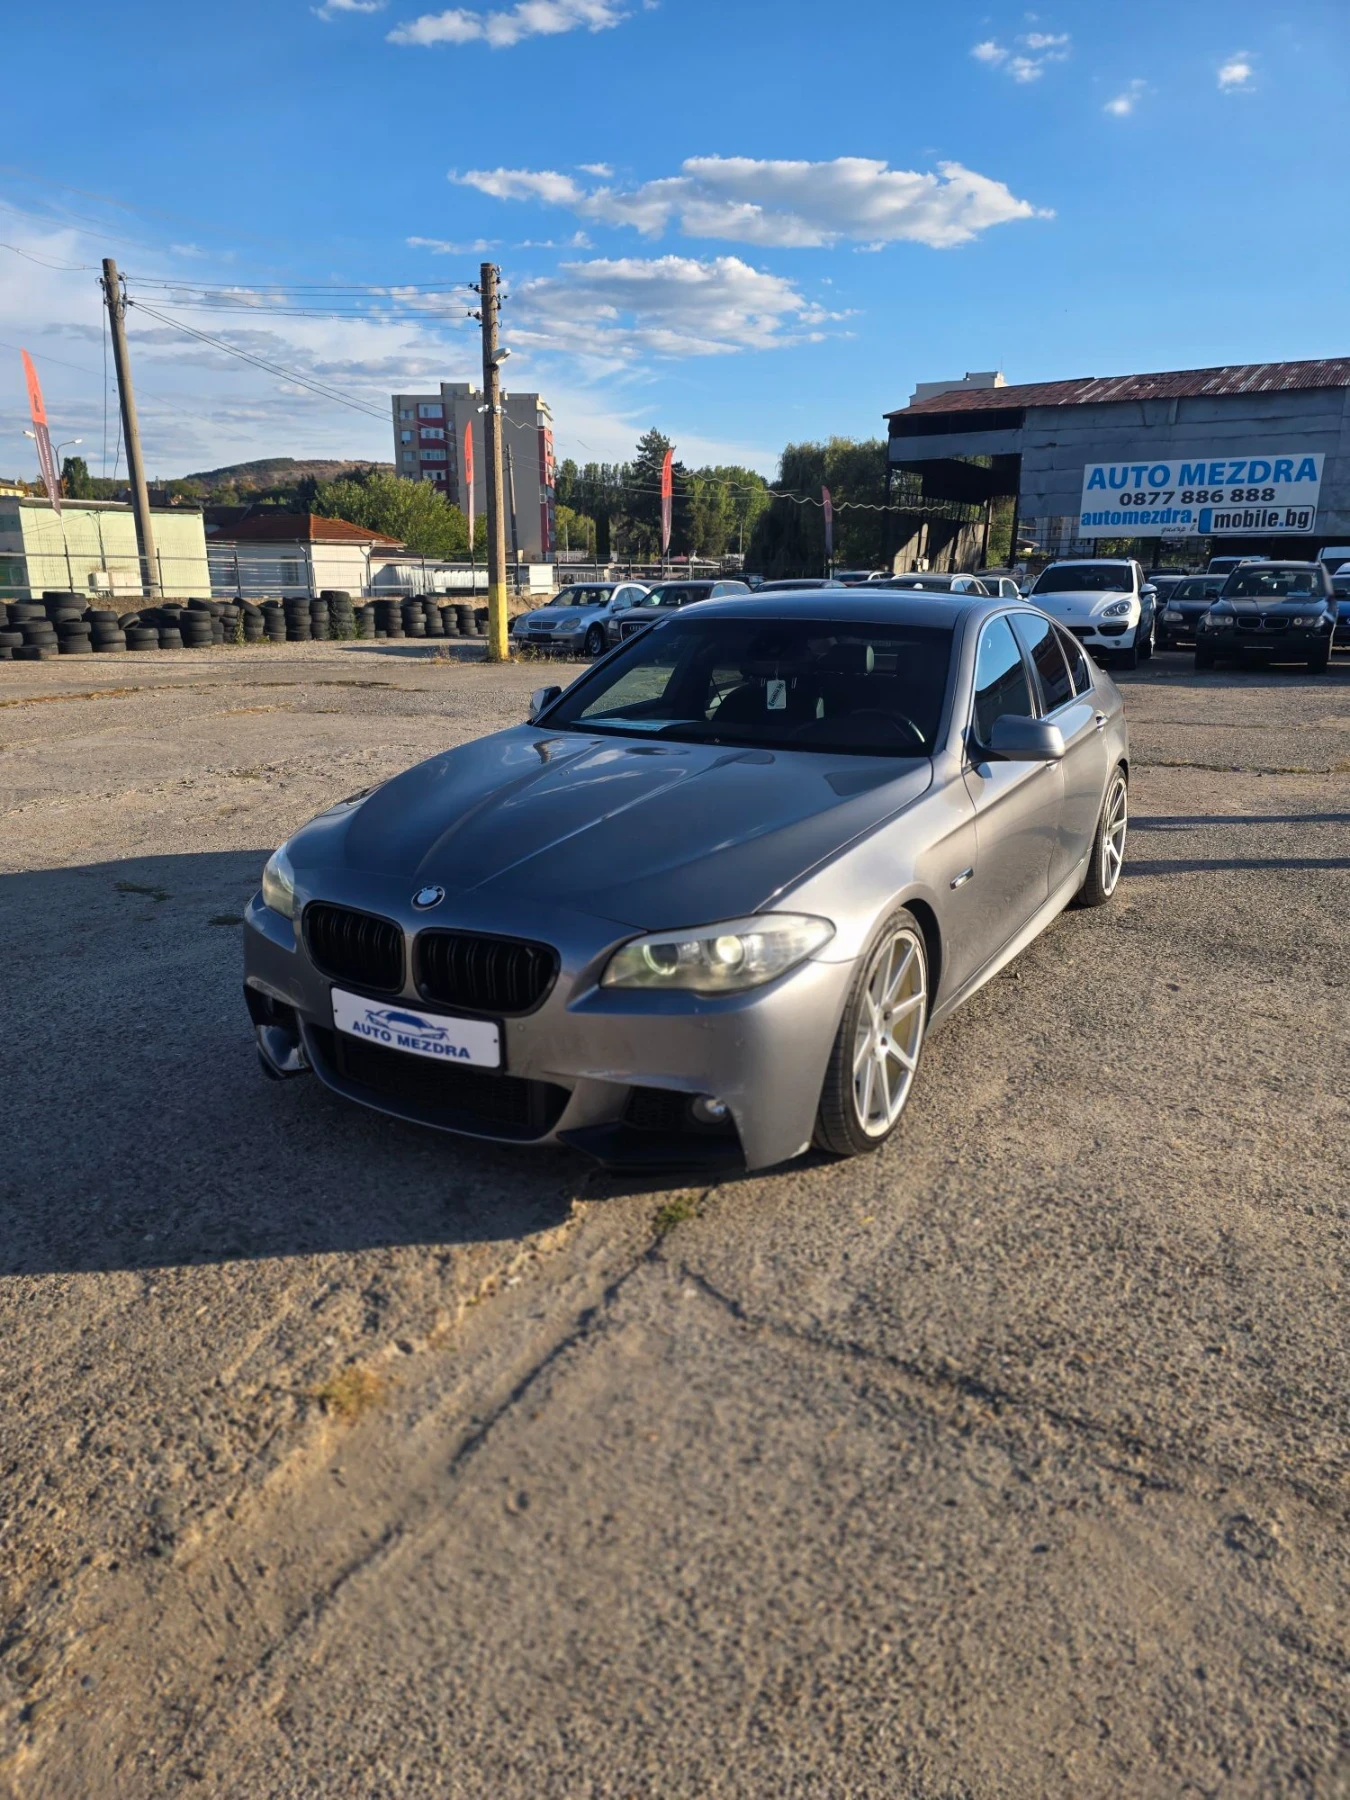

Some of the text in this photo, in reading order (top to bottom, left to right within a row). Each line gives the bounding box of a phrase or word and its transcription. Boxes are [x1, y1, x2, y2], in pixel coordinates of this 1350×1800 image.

[1087, 458, 1317, 490] AUTO MEZDRA
[1119, 488, 1275, 506] 0877 886 888
[1213, 508, 1310, 530] mobile.bg
[352, 1021, 471, 1059] AUTO MEZDRA
